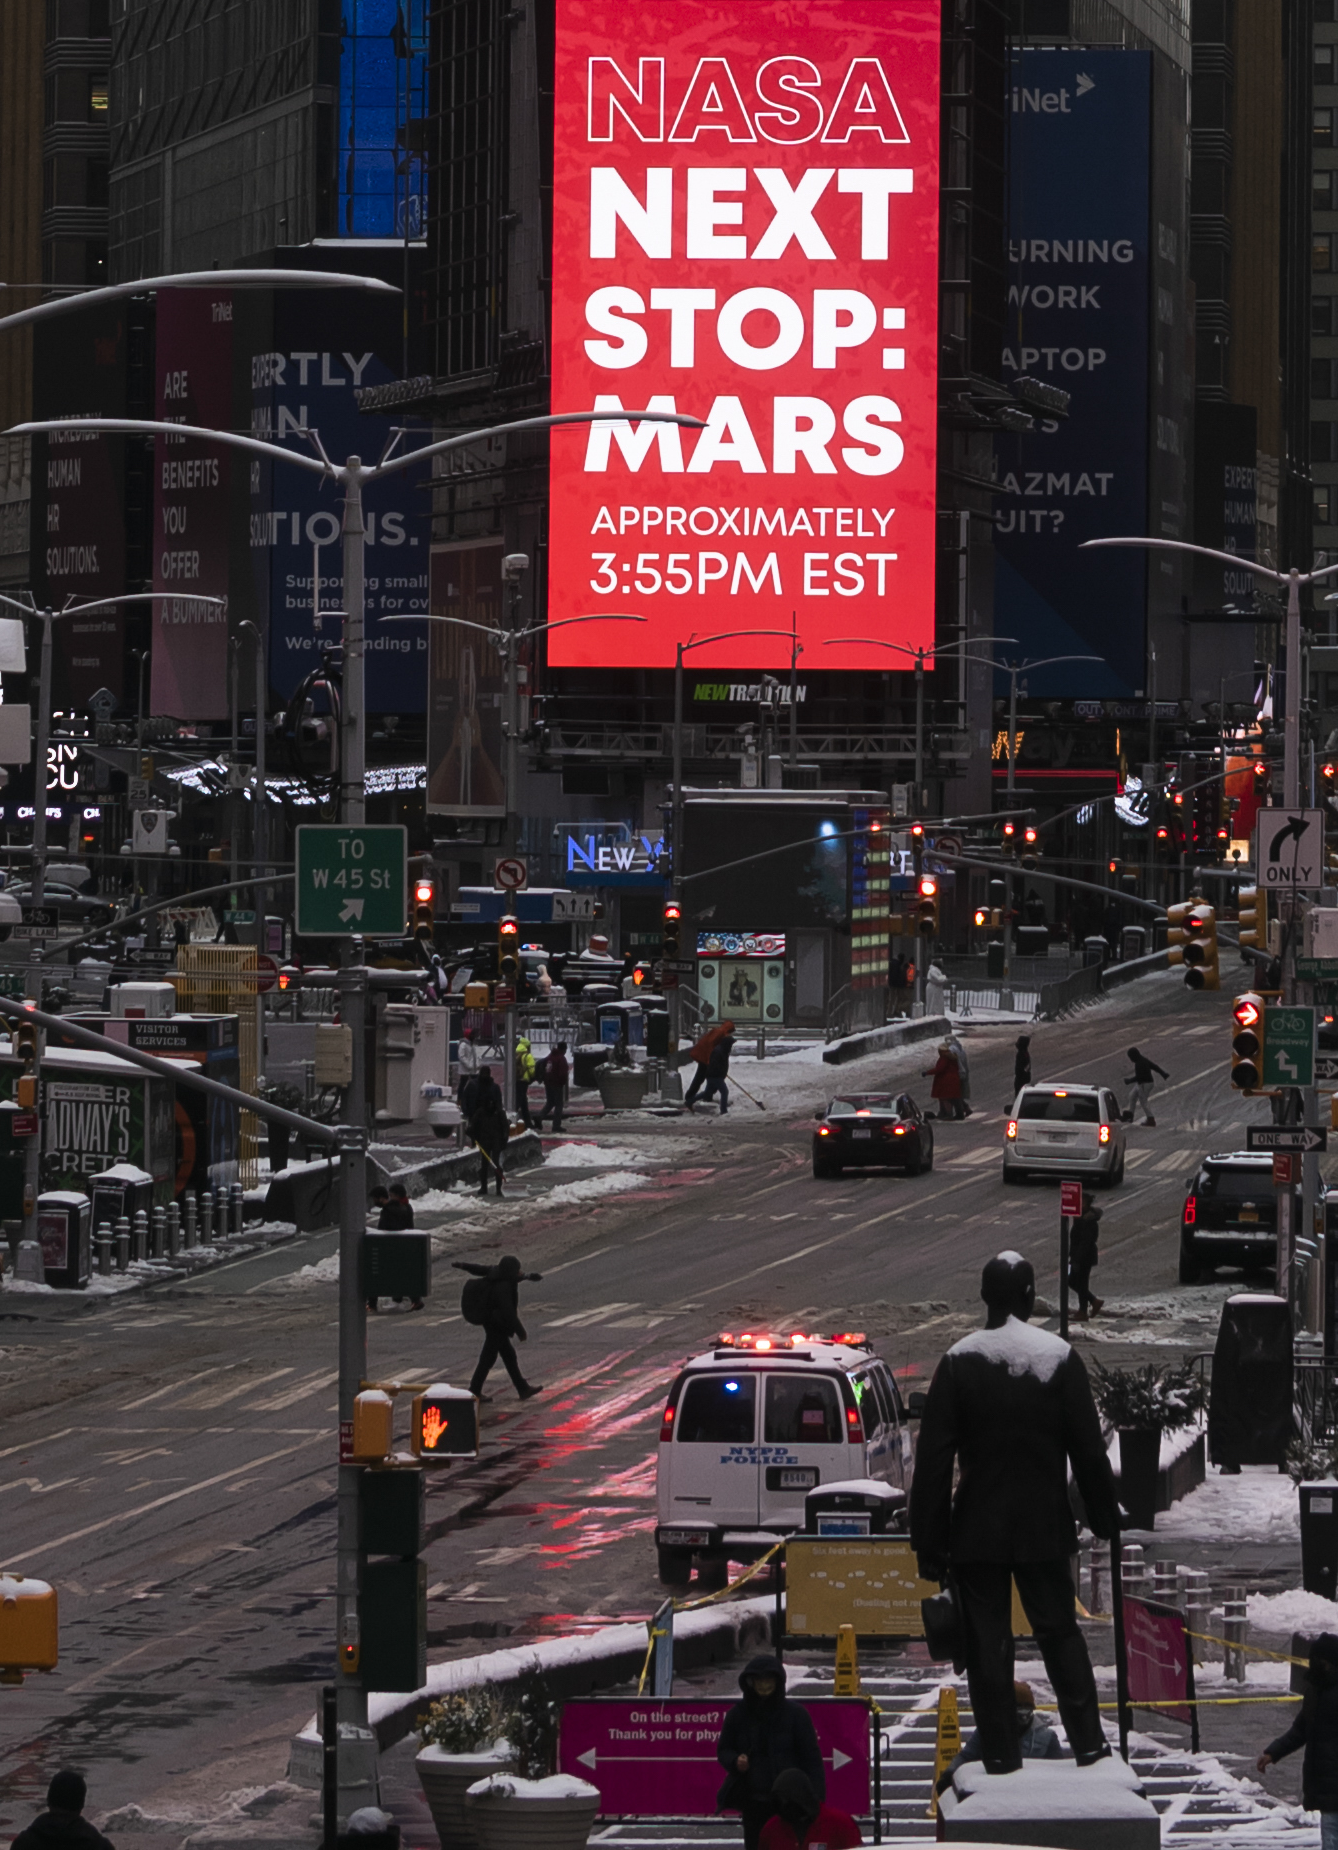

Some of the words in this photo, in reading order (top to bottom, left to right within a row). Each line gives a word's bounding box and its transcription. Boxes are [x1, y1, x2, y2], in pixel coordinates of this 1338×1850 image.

[588, 54, 910, 146] NASA
[589, 168, 914, 261] NEXT
[583, 287, 907, 371] STOP:
[251, 351, 374, 390] EXPERTLY
[164, 370, 188, 400] ARE
[583, 396, 906, 476] MARS
[47, 457, 81, 489] HUMAN
[162, 458, 220, 490] BENEFITS
[47, 504, 60, 532] HR
[162, 506, 187, 534] YOU
[590, 505, 896, 539] APPROXIMATELY
[46, 545, 100, 576] SOLUTIONS.
[161, 550, 200, 580] OFFER
[385, 574, 428, 588] small
[589, 552, 783, 597] 3:55PM
[803, 552, 898, 597] EST
[380, 595, 405, 608] for
[337, 838, 365, 859] TO
[311, 868, 329, 889] W
[332, 868, 364, 889] 45
[369, 868, 391, 890] St
[1266, 866, 1313, 883] ONLY
[34, 927, 57, 938] LANE
[0, 978, 13, 992] 45
[1316, 986, 1329, 1002] W
[135, 1024, 179, 1035] VISITOR
[135, 1036, 187, 1047] SERVICES
[1266, 1037, 1310, 1049] Broadway
[1316, 1063, 1335, 1076] WAY
[1257, 1132, 1283, 1146] ONE
[1289, 1131, 1314, 1145] WAY
[720, 1455, 799, 1465] POLICE
[730, 1447, 789, 1456] NYPD
[828, 1546, 847, 1556] feet
[630, 1711, 648, 1723] On
[650, 1711, 672, 1723] the
[674, 1711, 720, 1723] street?
[608, 1728, 648, 1740] Thank
[650, 1730, 672, 1742] you
[675, 1728, 693, 1740] for
